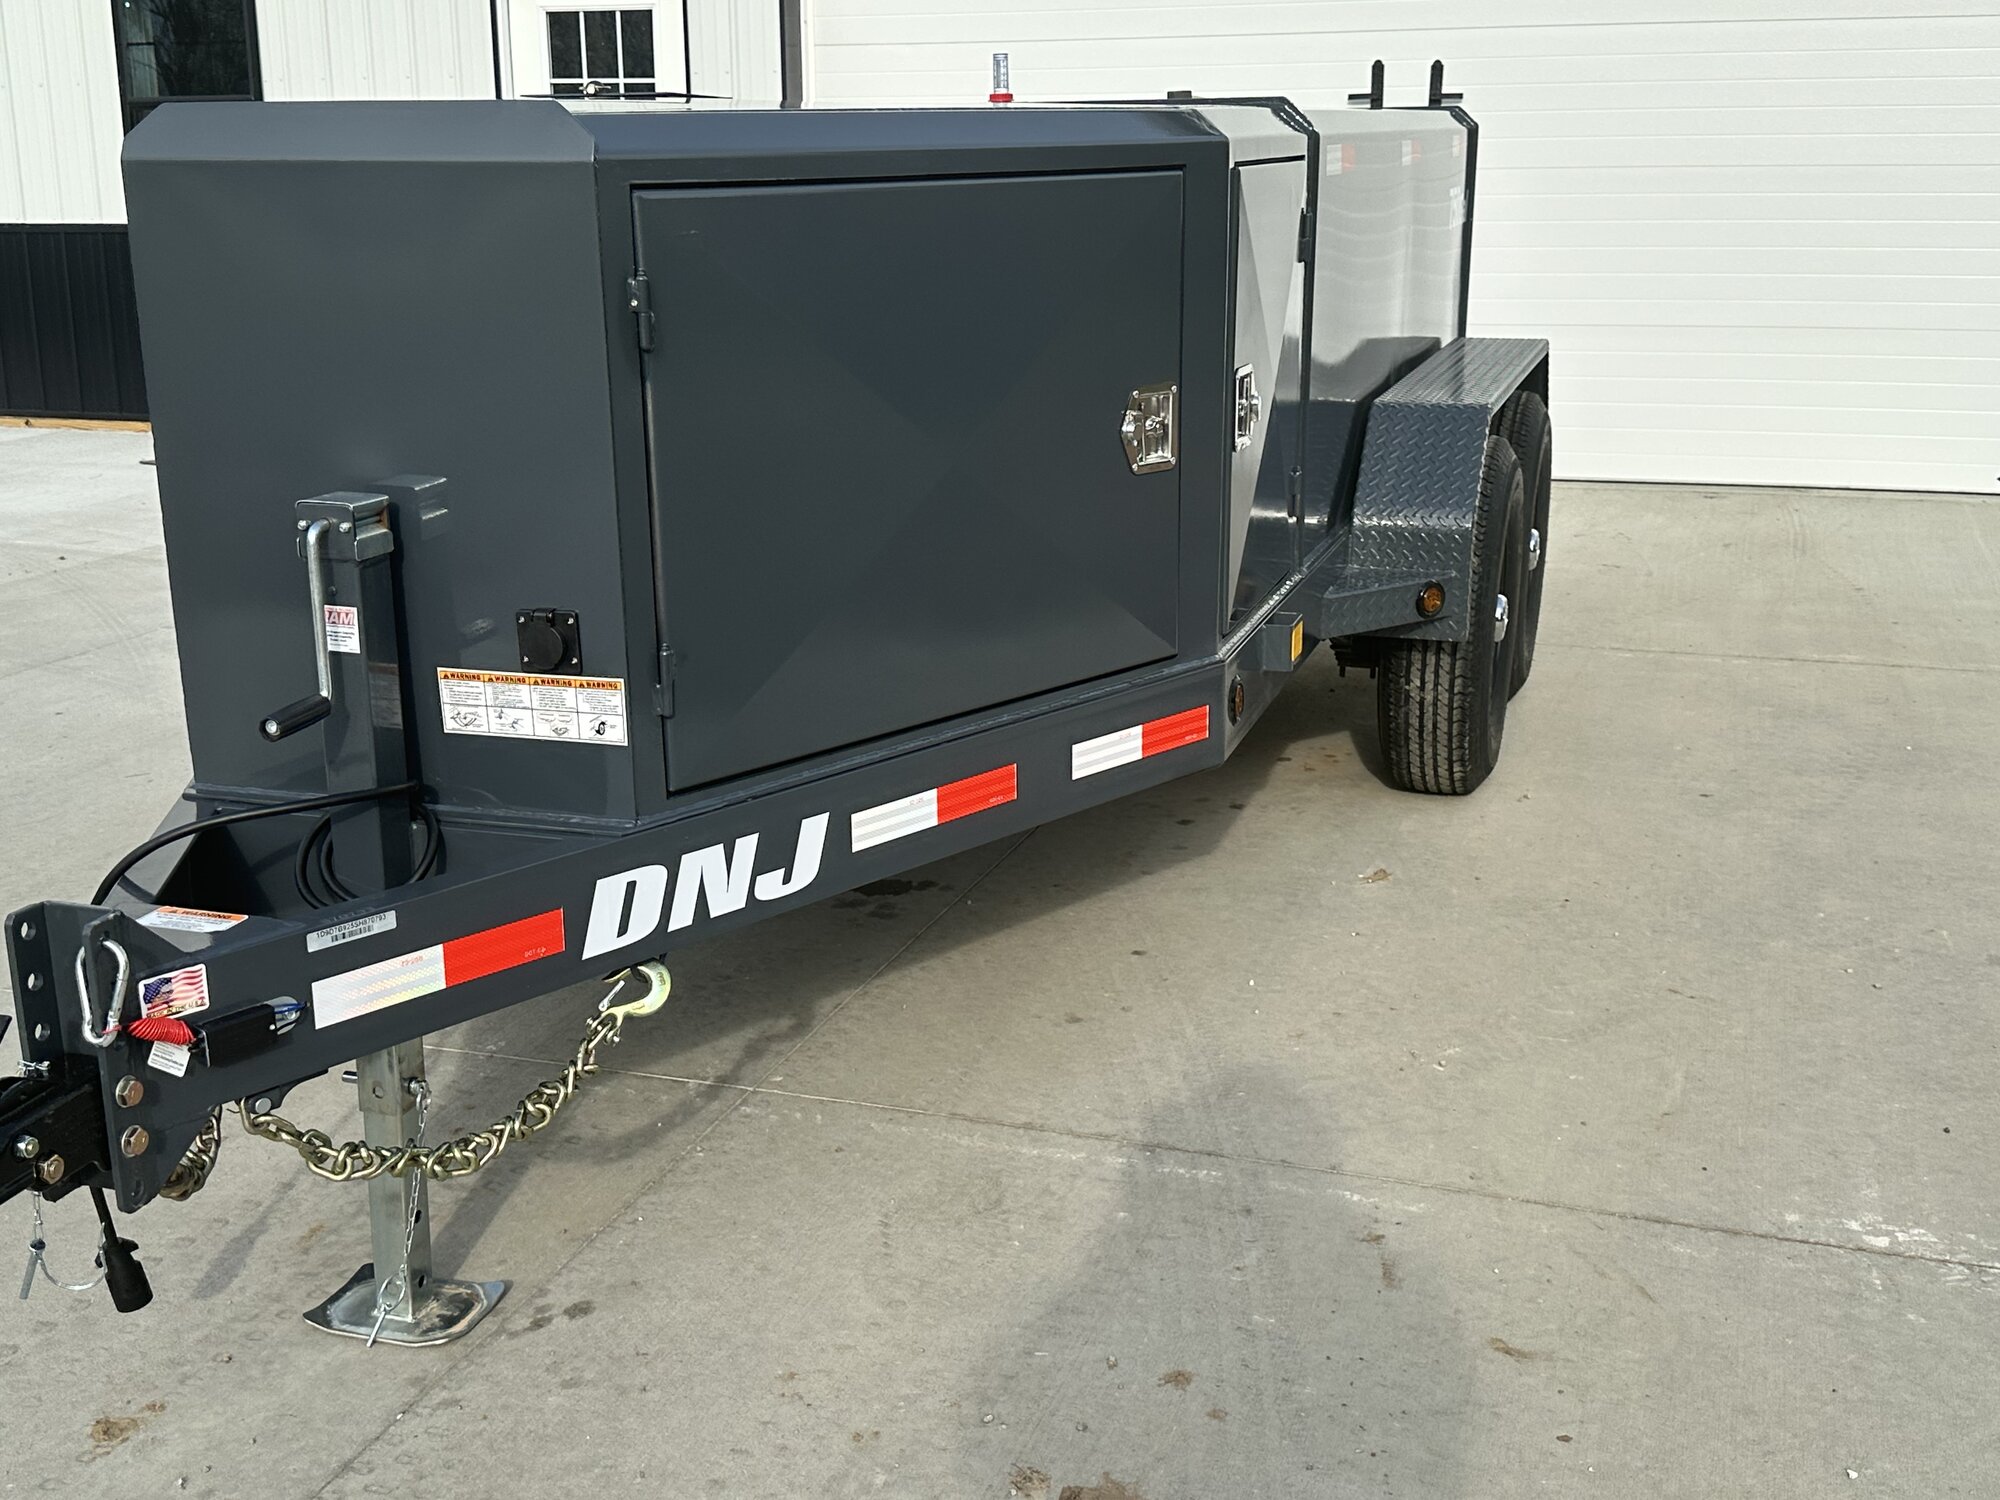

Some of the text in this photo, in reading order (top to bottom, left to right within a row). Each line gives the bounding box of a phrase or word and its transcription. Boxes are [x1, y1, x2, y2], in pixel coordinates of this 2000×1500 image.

[449, 673, 481, 681] WARNING
[494, 676, 527, 684] WARNING
[582, 812, 830, 960] DNJ
